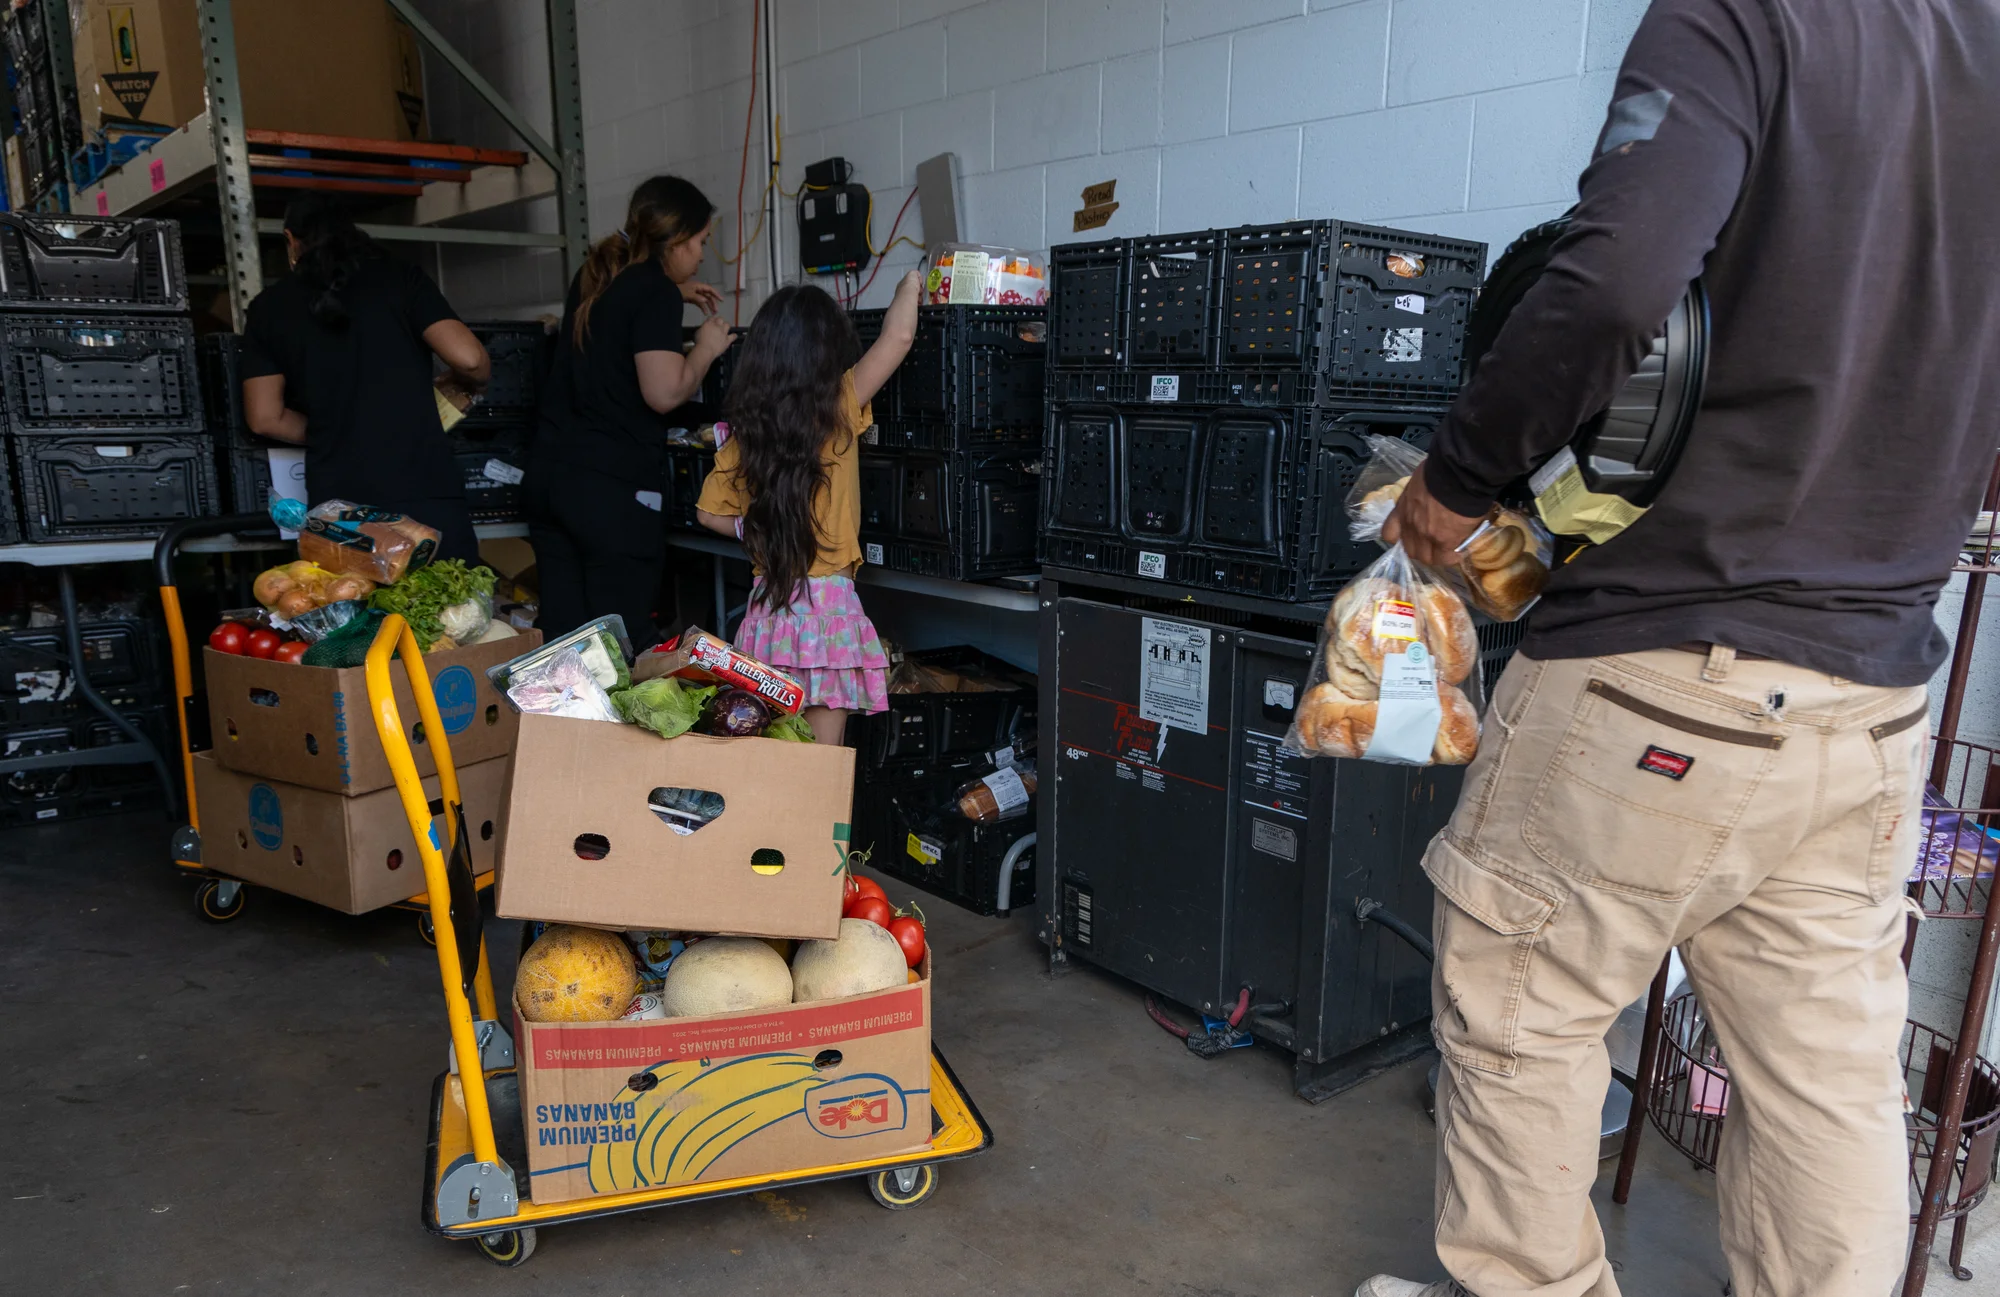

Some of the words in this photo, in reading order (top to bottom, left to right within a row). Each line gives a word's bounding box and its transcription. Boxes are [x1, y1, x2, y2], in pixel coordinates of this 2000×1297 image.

[111, 80, 151, 90] WATCH
[120, 92, 147, 103] STEP
[1156, 377, 1173, 385] IFCO
[1143, 554, 1160, 563] IFCO
[733, 660, 766, 682] KILLER
[764, 674, 787, 688] CLASSIC
[757, 680, 796, 707] ROLLS
[1066, 747, 1080, 760] 48
[1264, 824, 1286, 835] FORKLIFT
[863, 1010, 913, 1030] PREMIUM
[808, 1019, 861, 1039] BANANAS
[679, 1038, 735, 1054] BANANAS
[739, 1031, 793, 1048] PREMIUM
[545, 1049, 602, 1061] BANANAS
[606, 1046, 661, 1059] PREMIUM
[535, 1101, 636, 1124] BANANAS
[819, 1098, 888, 1131] Dole
[539, 1123, 636, 1147] PREMIUM
